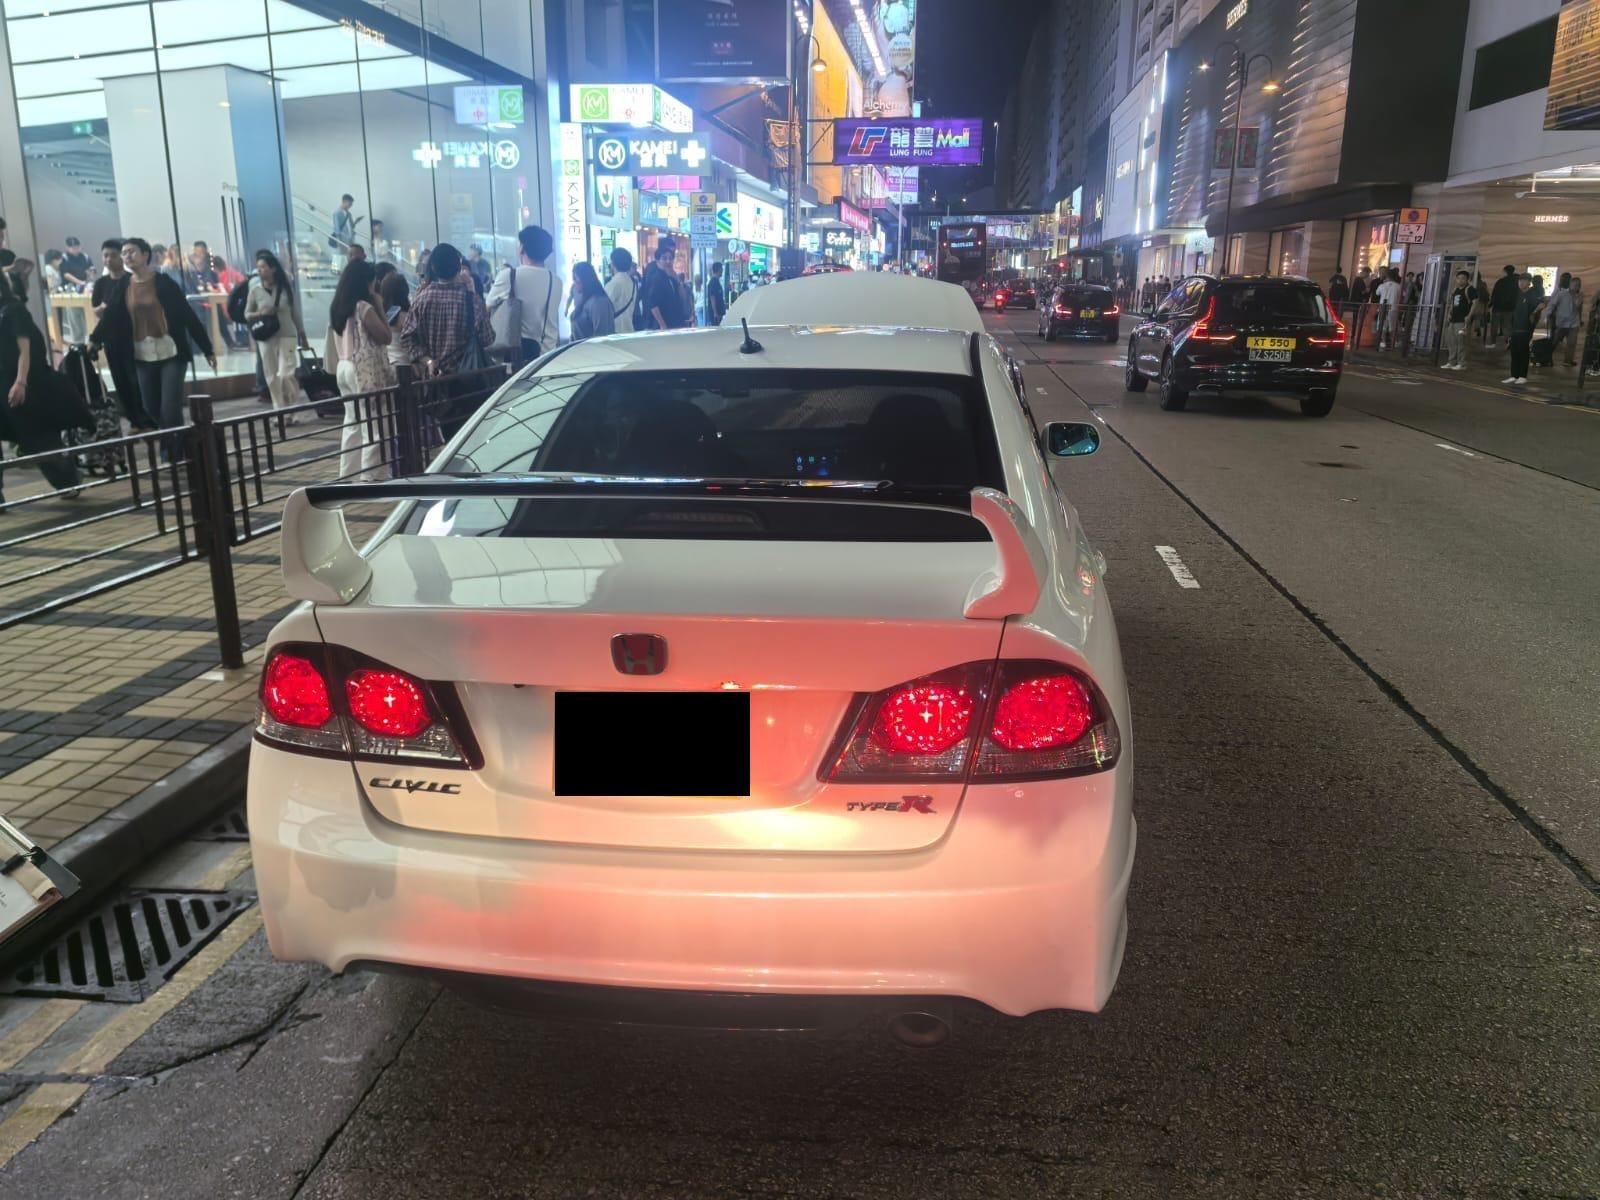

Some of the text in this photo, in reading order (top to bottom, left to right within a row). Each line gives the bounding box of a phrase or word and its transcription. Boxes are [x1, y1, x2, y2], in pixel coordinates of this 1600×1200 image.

[935, 127, 970, 149] Mall
[628, 140, 679, 155] KAMEI
[890, 148, 933, 157] LUNG FUNG
[1415, 225, 1421, 233] 7
[1414, 235, 1423, 243] 12
[1253, 338, 1290, 348] XT 550
[369, 777, 462, 794] CIVIC
[846, 795, 938, 814] TYPE R
